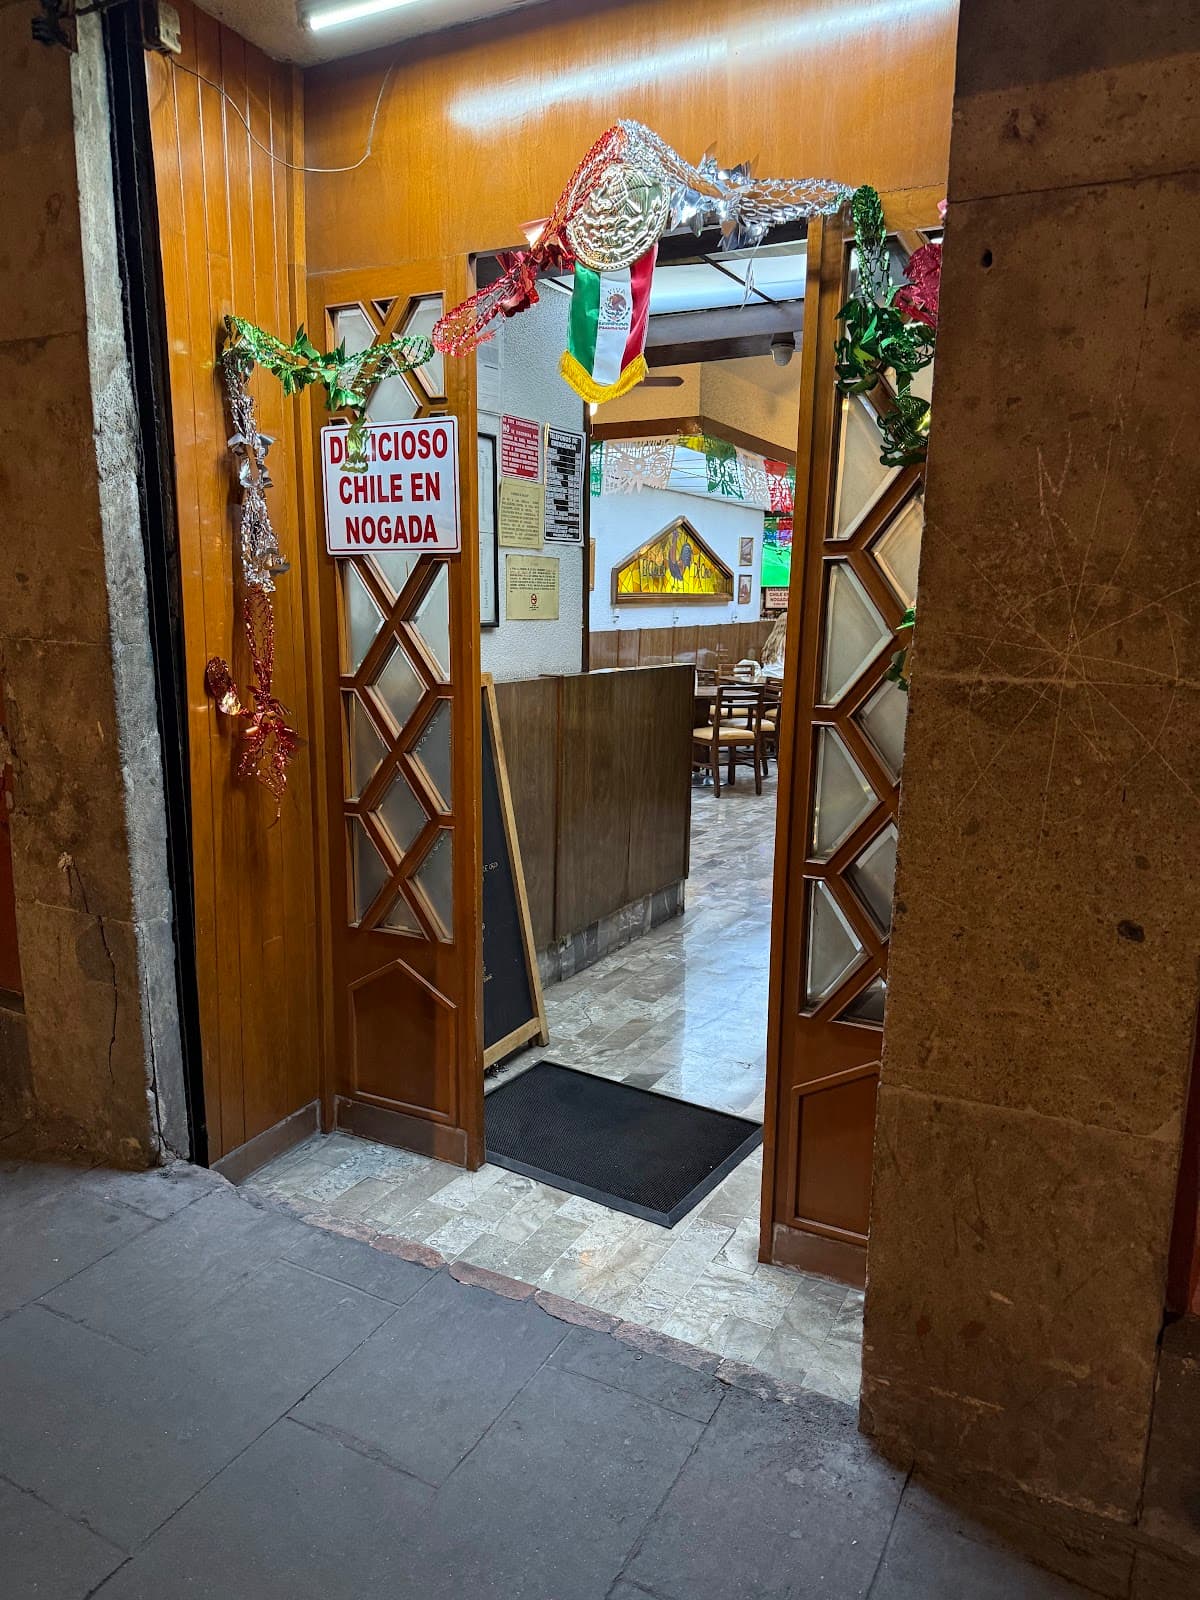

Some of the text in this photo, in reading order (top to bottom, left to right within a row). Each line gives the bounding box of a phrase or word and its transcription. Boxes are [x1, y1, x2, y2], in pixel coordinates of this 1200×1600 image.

[503, 423, 510, 432] NO
[329, 428, 448, 464] DICIOSO
[339, 472, 440, 504] CHILE EN
[345, 515, 438, 544] NOGADA
